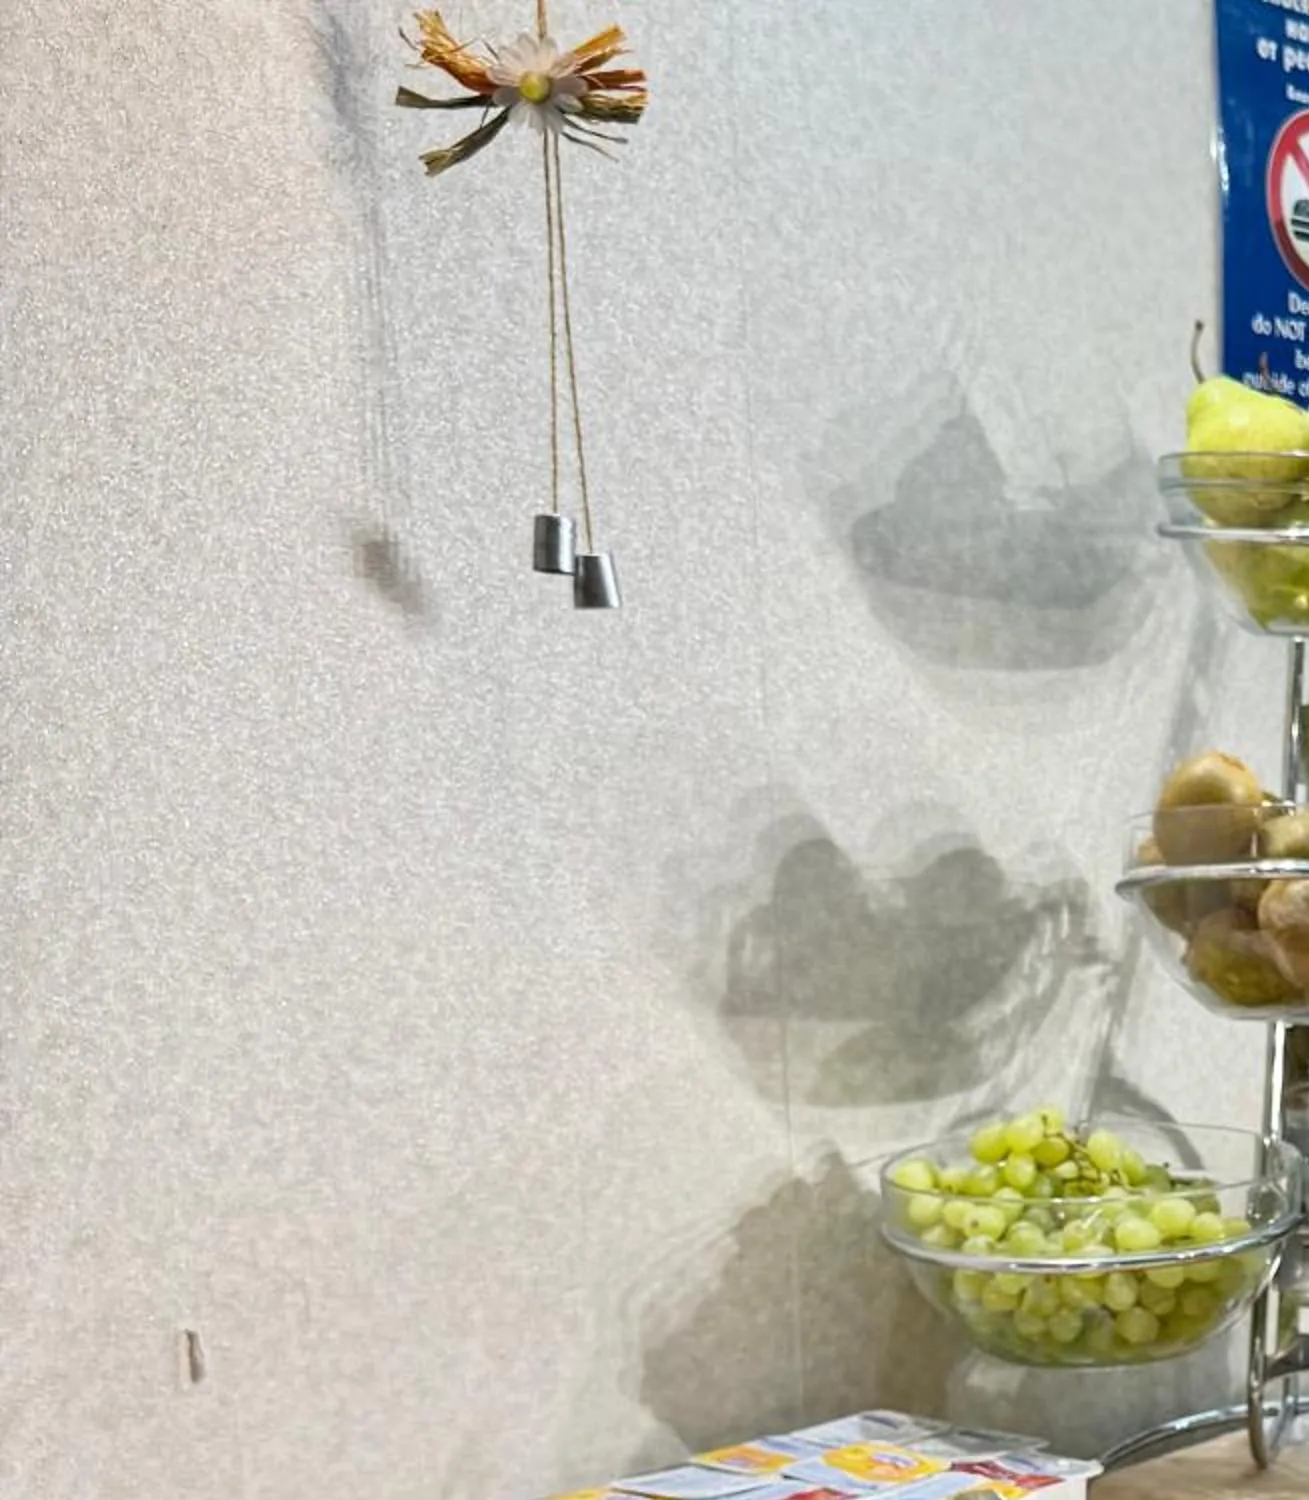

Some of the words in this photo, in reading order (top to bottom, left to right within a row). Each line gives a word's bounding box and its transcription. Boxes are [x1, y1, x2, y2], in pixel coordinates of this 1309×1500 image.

[1256, 37, 1278, 62] от
[1251, 311, 1273, 336] do
[1273, 316, 1307, 343] NOT
